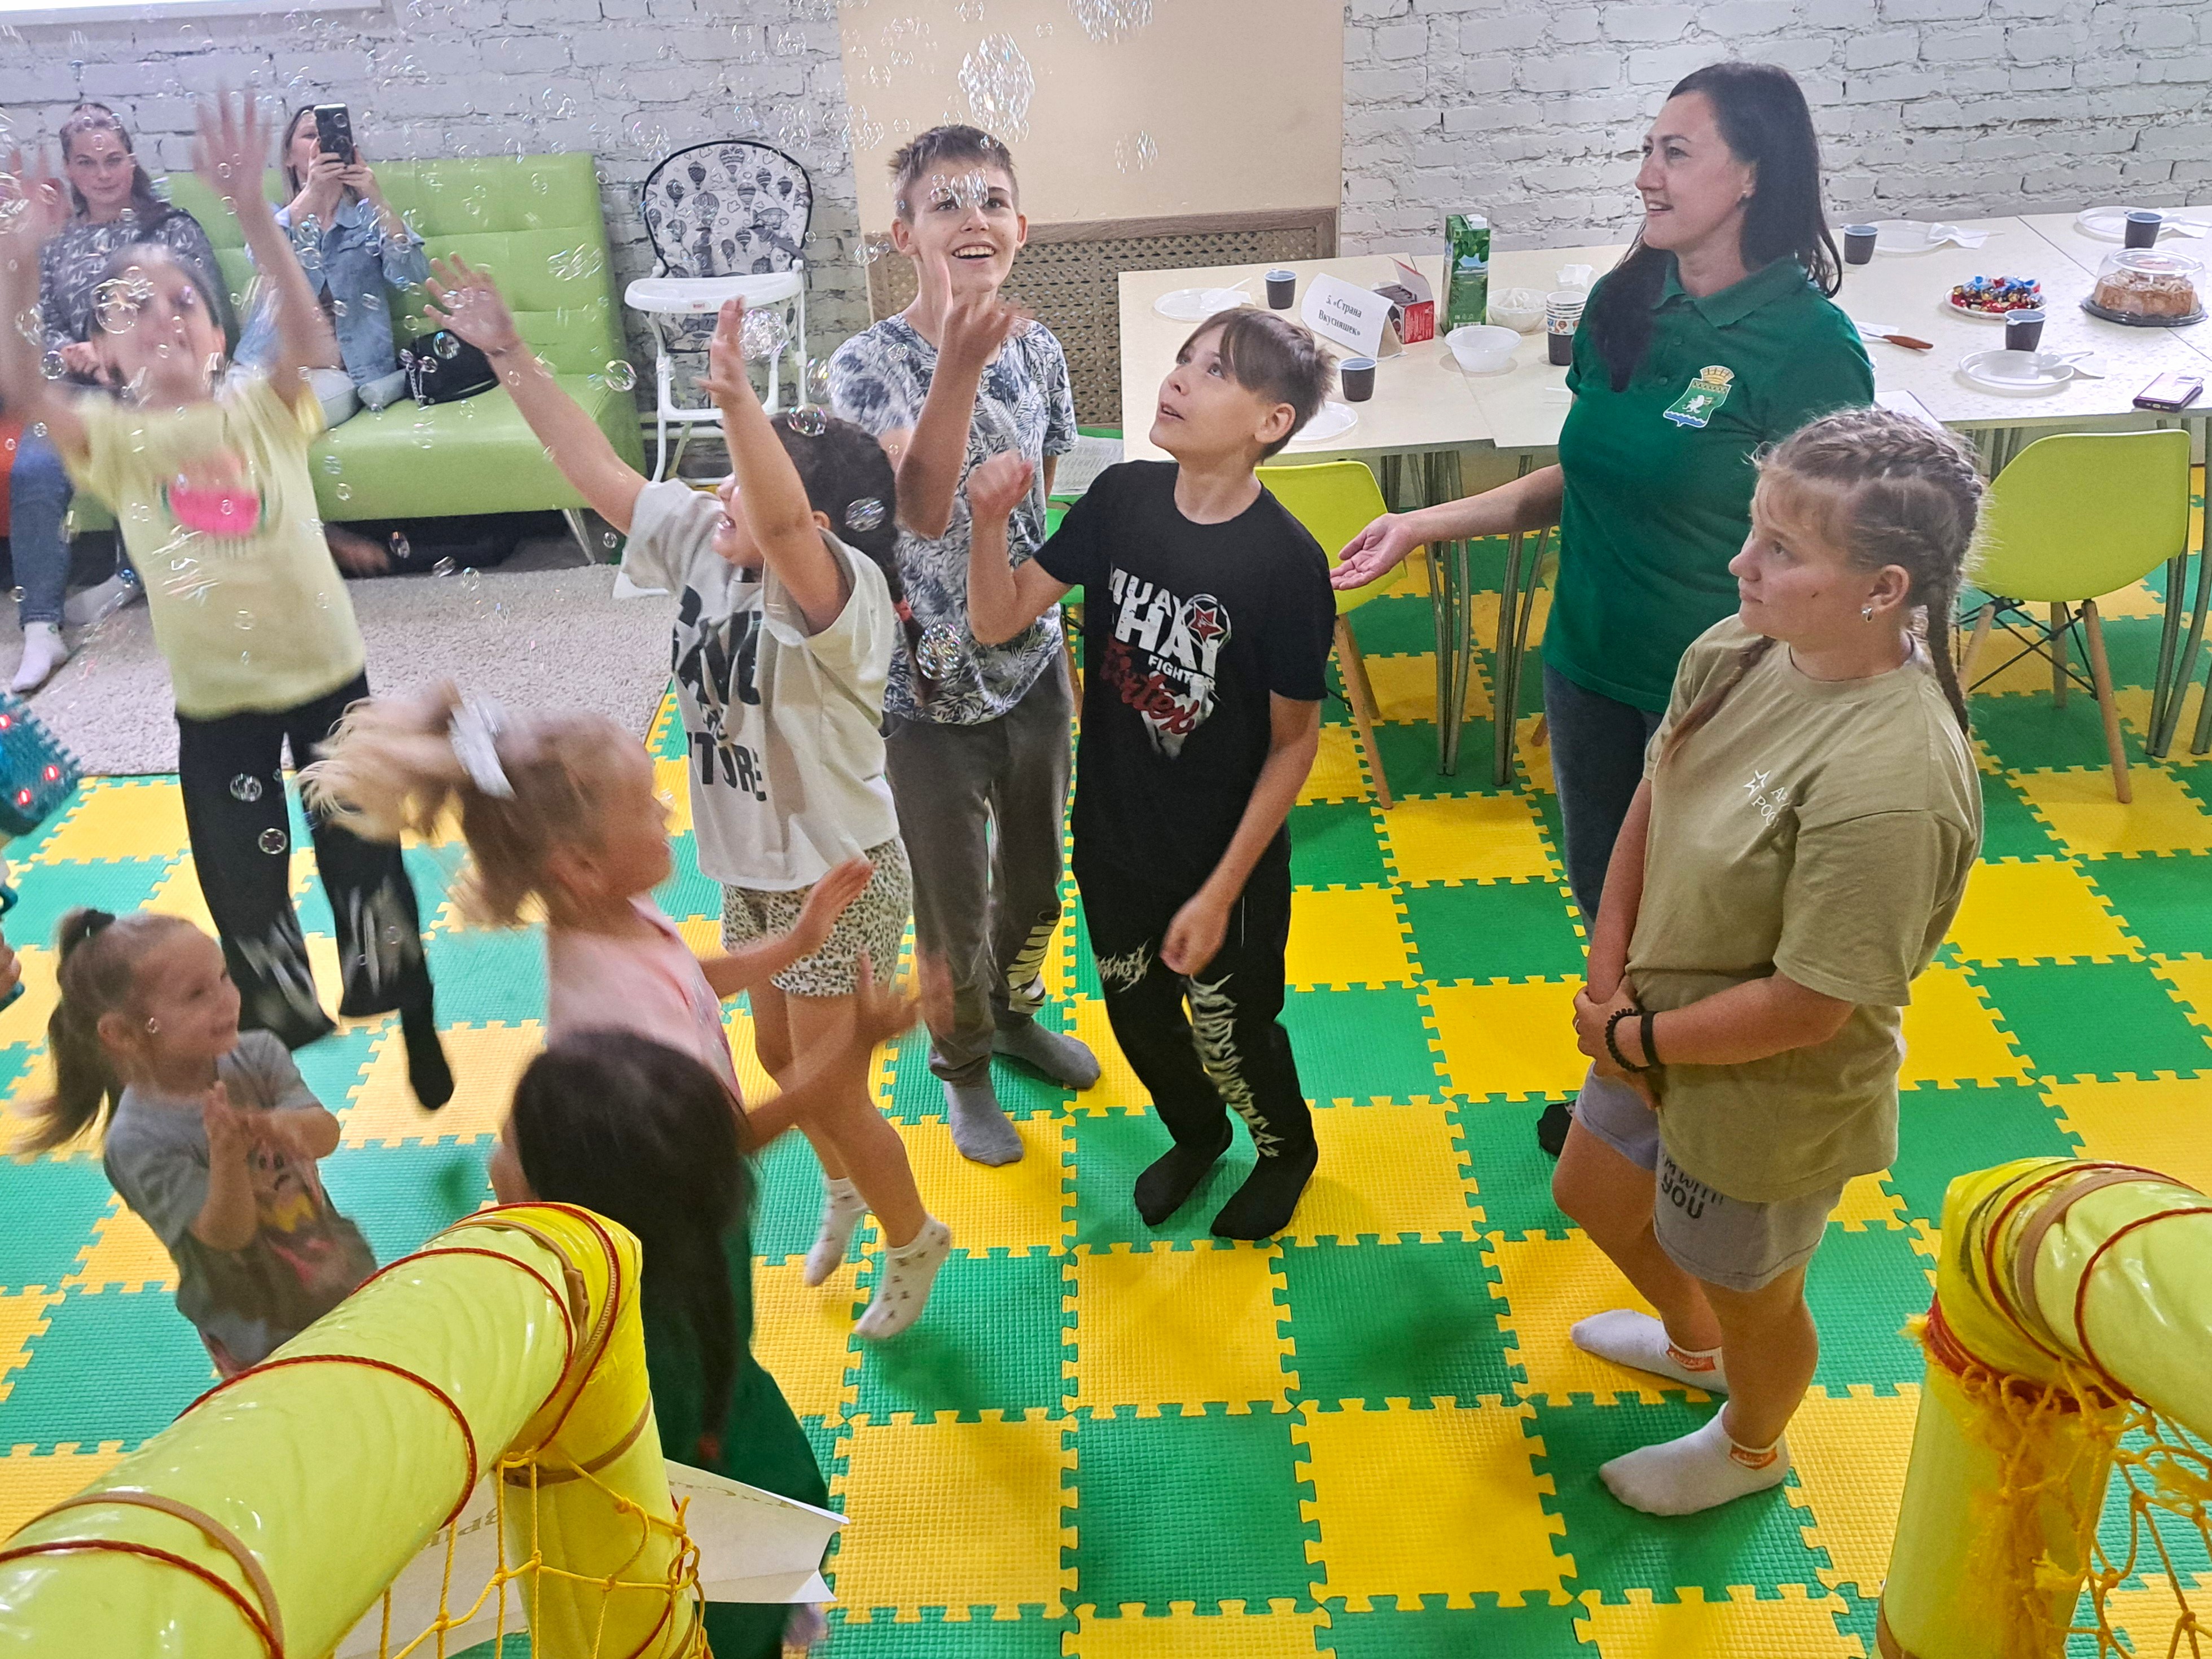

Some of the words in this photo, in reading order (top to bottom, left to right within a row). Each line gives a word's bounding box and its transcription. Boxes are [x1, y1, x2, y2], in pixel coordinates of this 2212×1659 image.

[1318, 309, 1362, 336] Вкусняшек»
[1333, 299, 1362, 318] «Страна
[1148, 655, 1216, 691] FIGHTER
[1661, 1173, 1705, 1219] YOU
